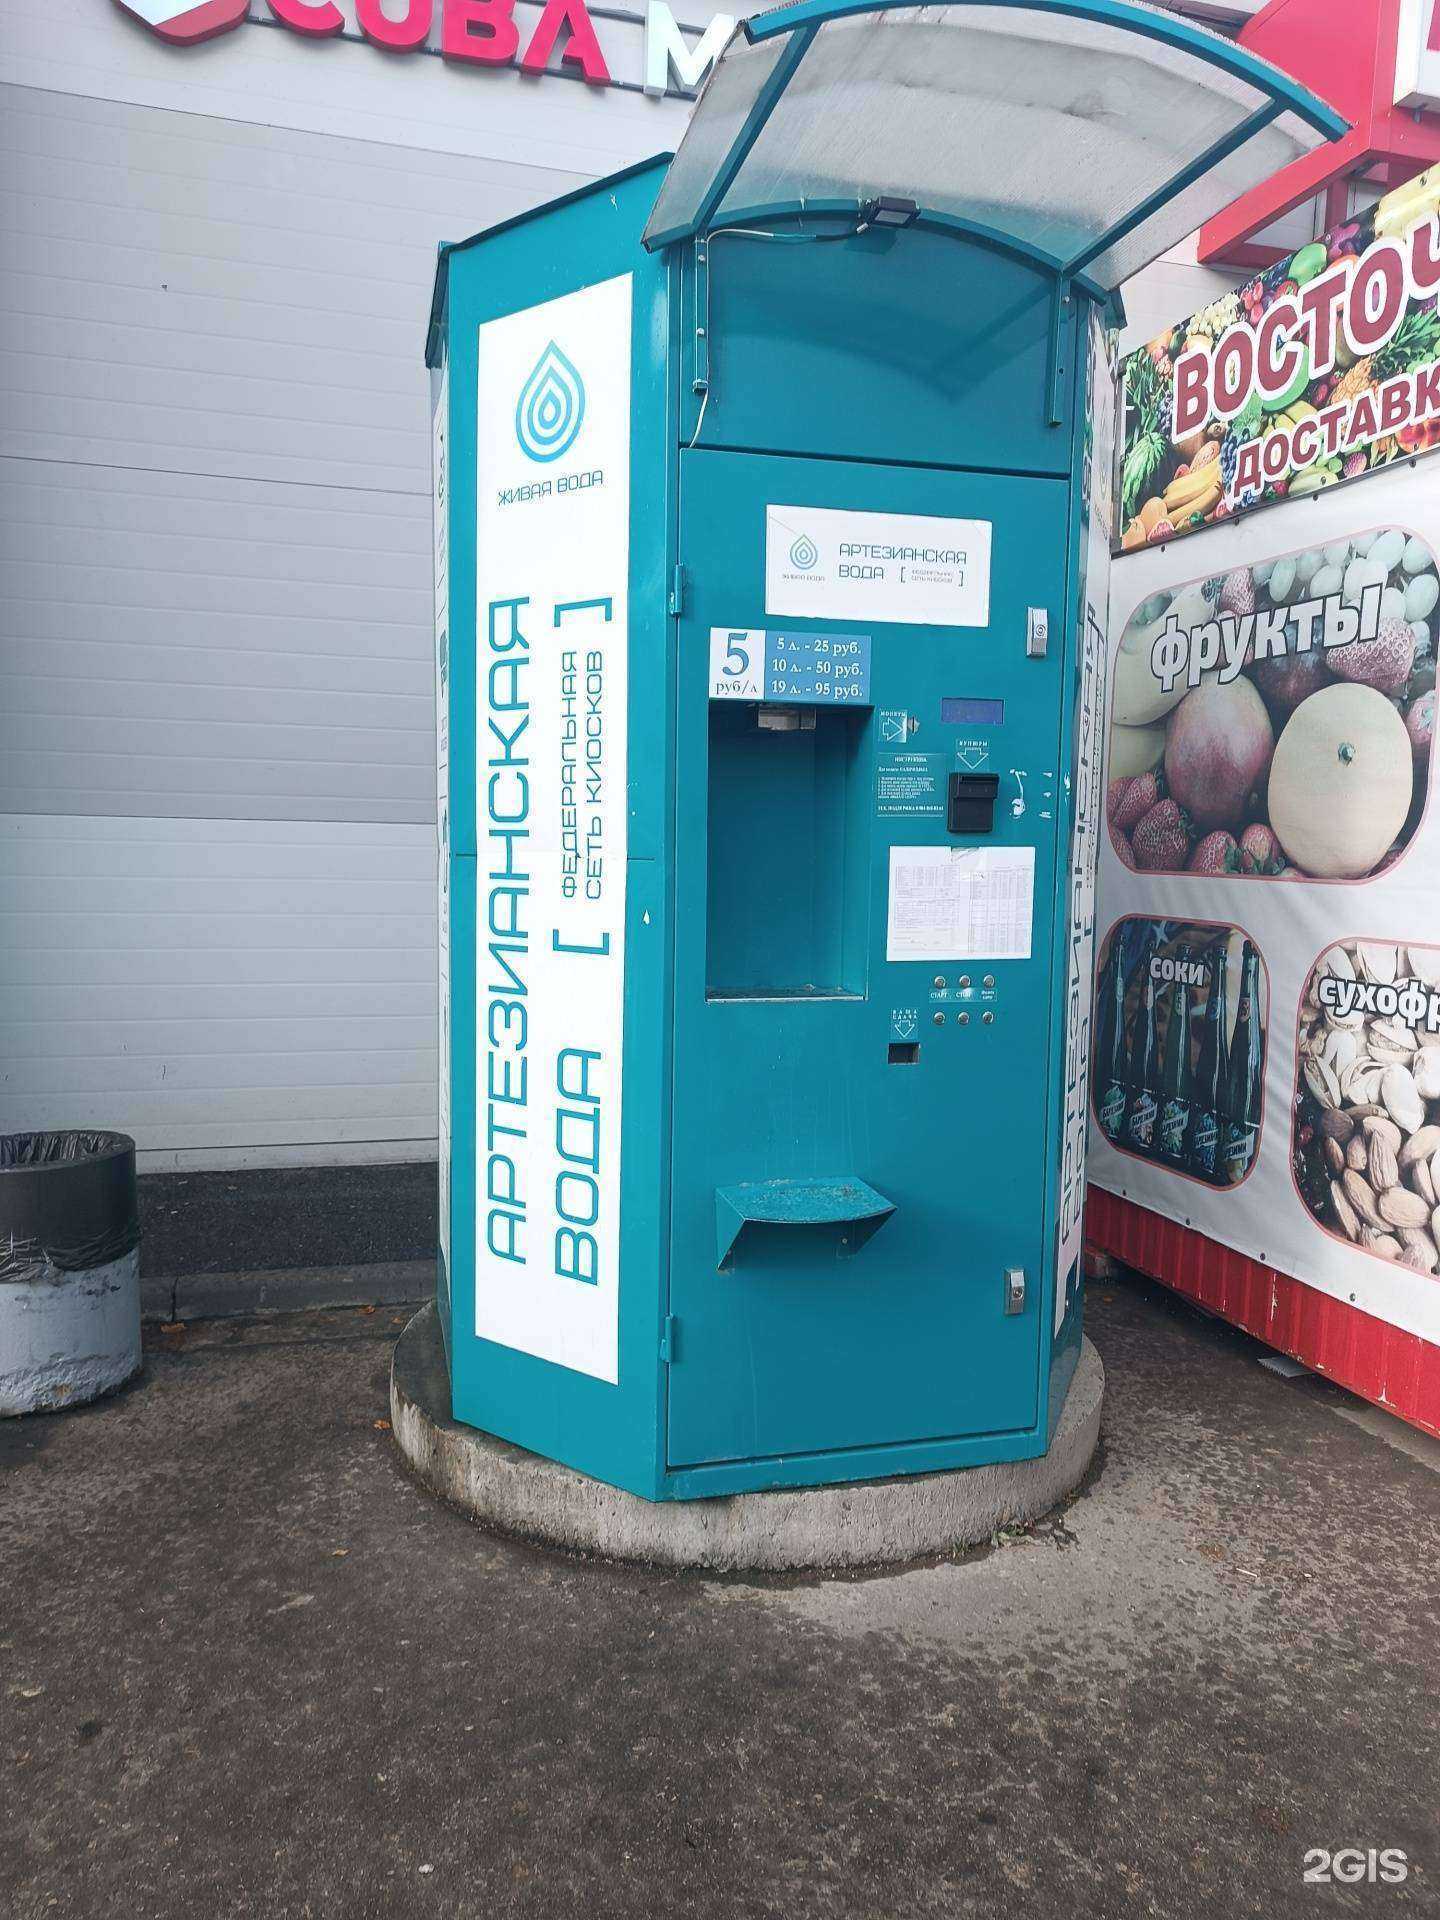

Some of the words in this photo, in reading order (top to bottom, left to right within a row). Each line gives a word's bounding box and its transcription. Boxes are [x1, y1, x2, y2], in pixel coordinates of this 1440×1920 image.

[498, 480, 552, 507] ЖИВАЯ
[557, 469, 603, 493] ВОДА
[838, 564, 885, 580] ВОДА
[839, 542, 968, 565] АРТЕЗИАНСКАЯ
[722, 632, 750, 676] 5
[776, 637, 785, 650] 5
[814, 639, 829, 652] 25
[833, 640, 862, 657] руб.
[772, 658, 787, 672] 10
[816, 660, 831, 674] 50
[834, 662, 863, 679] руб.
[771, 680, 786, 694] 19
[815, 682, 831, 697] 95
[834, 684, 863, 701] руб.
[586, 650, 603, 804] КИОСКОВ
[561, 650, 578, 899] ФЕДЕРАЛЬНАЯ
[586, 815, 603, 900] СЕТЬ
[488, 596, 530, 1265] АРТЕЗИАНСКАЯ
[554, 1047, 602, 1286] ВОДА
